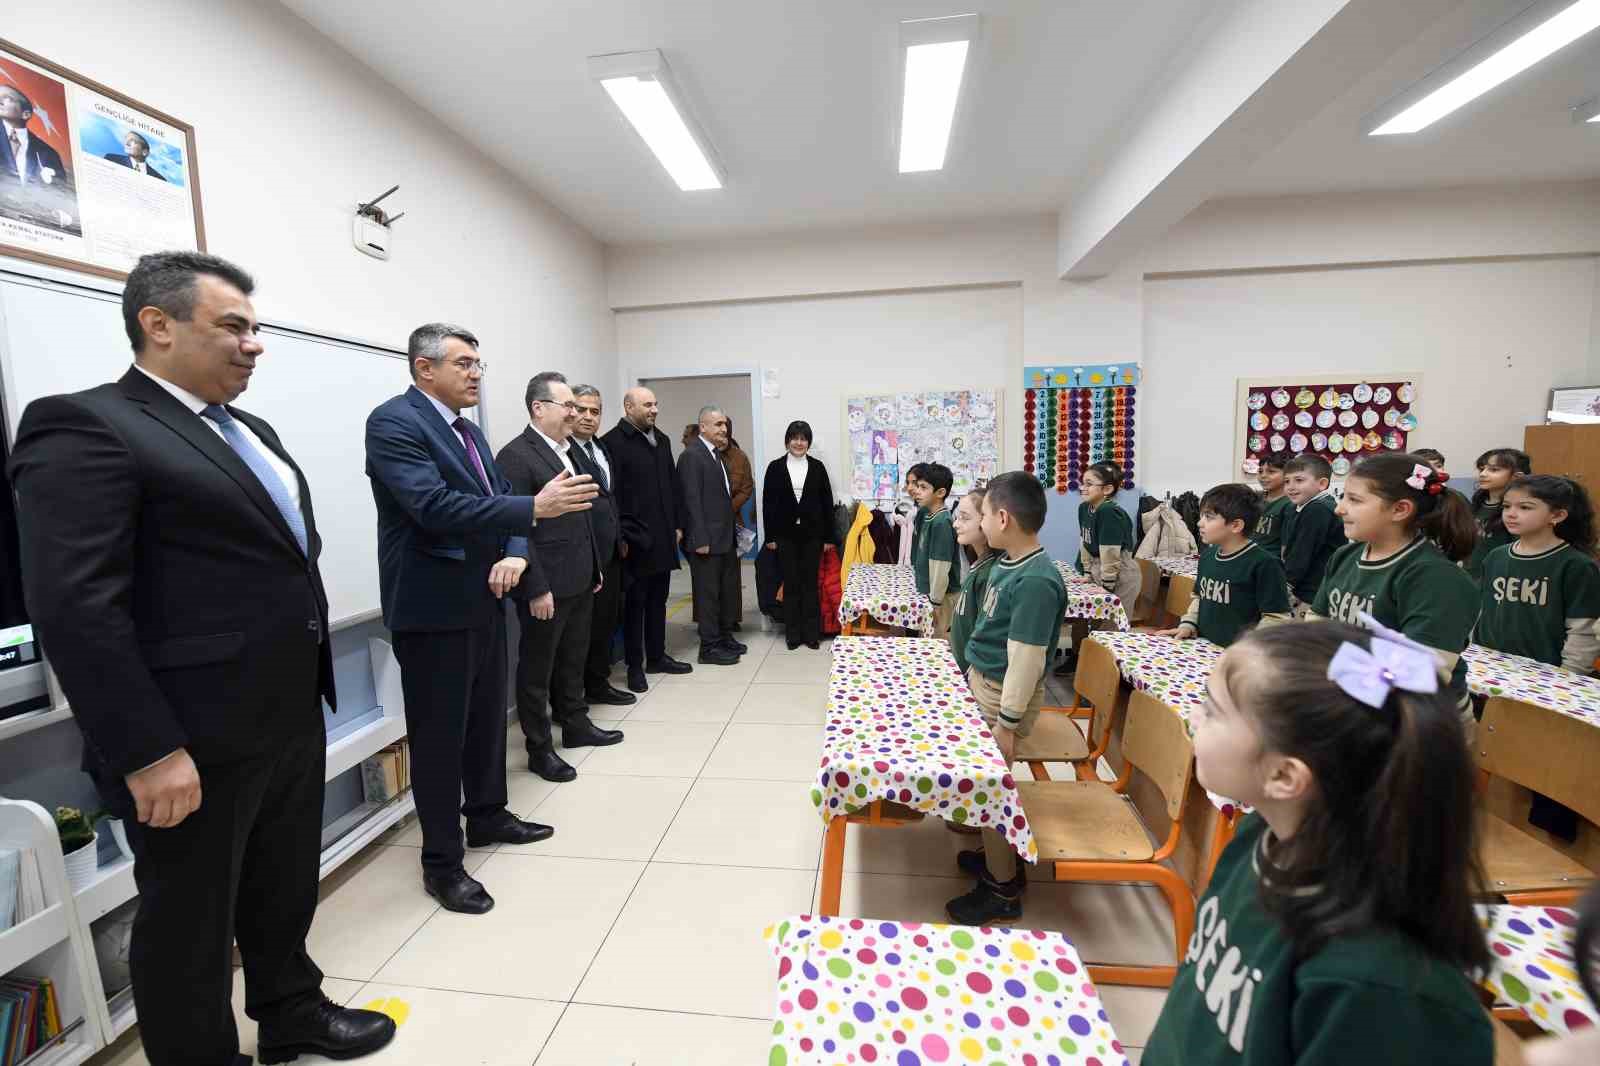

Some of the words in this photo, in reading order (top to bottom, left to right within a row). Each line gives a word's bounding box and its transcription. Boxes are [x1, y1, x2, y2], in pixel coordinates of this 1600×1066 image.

[1256, 513, 1273, 535] Kİ
[1200, 576, 1230, 604] ŞEKİ
[1493, 576, 1549, 605] ŞEKİ
[1329, 588, 1376, 625] ŞEKİ
[1185, 896, 1263, 1054] ŞEKİ
